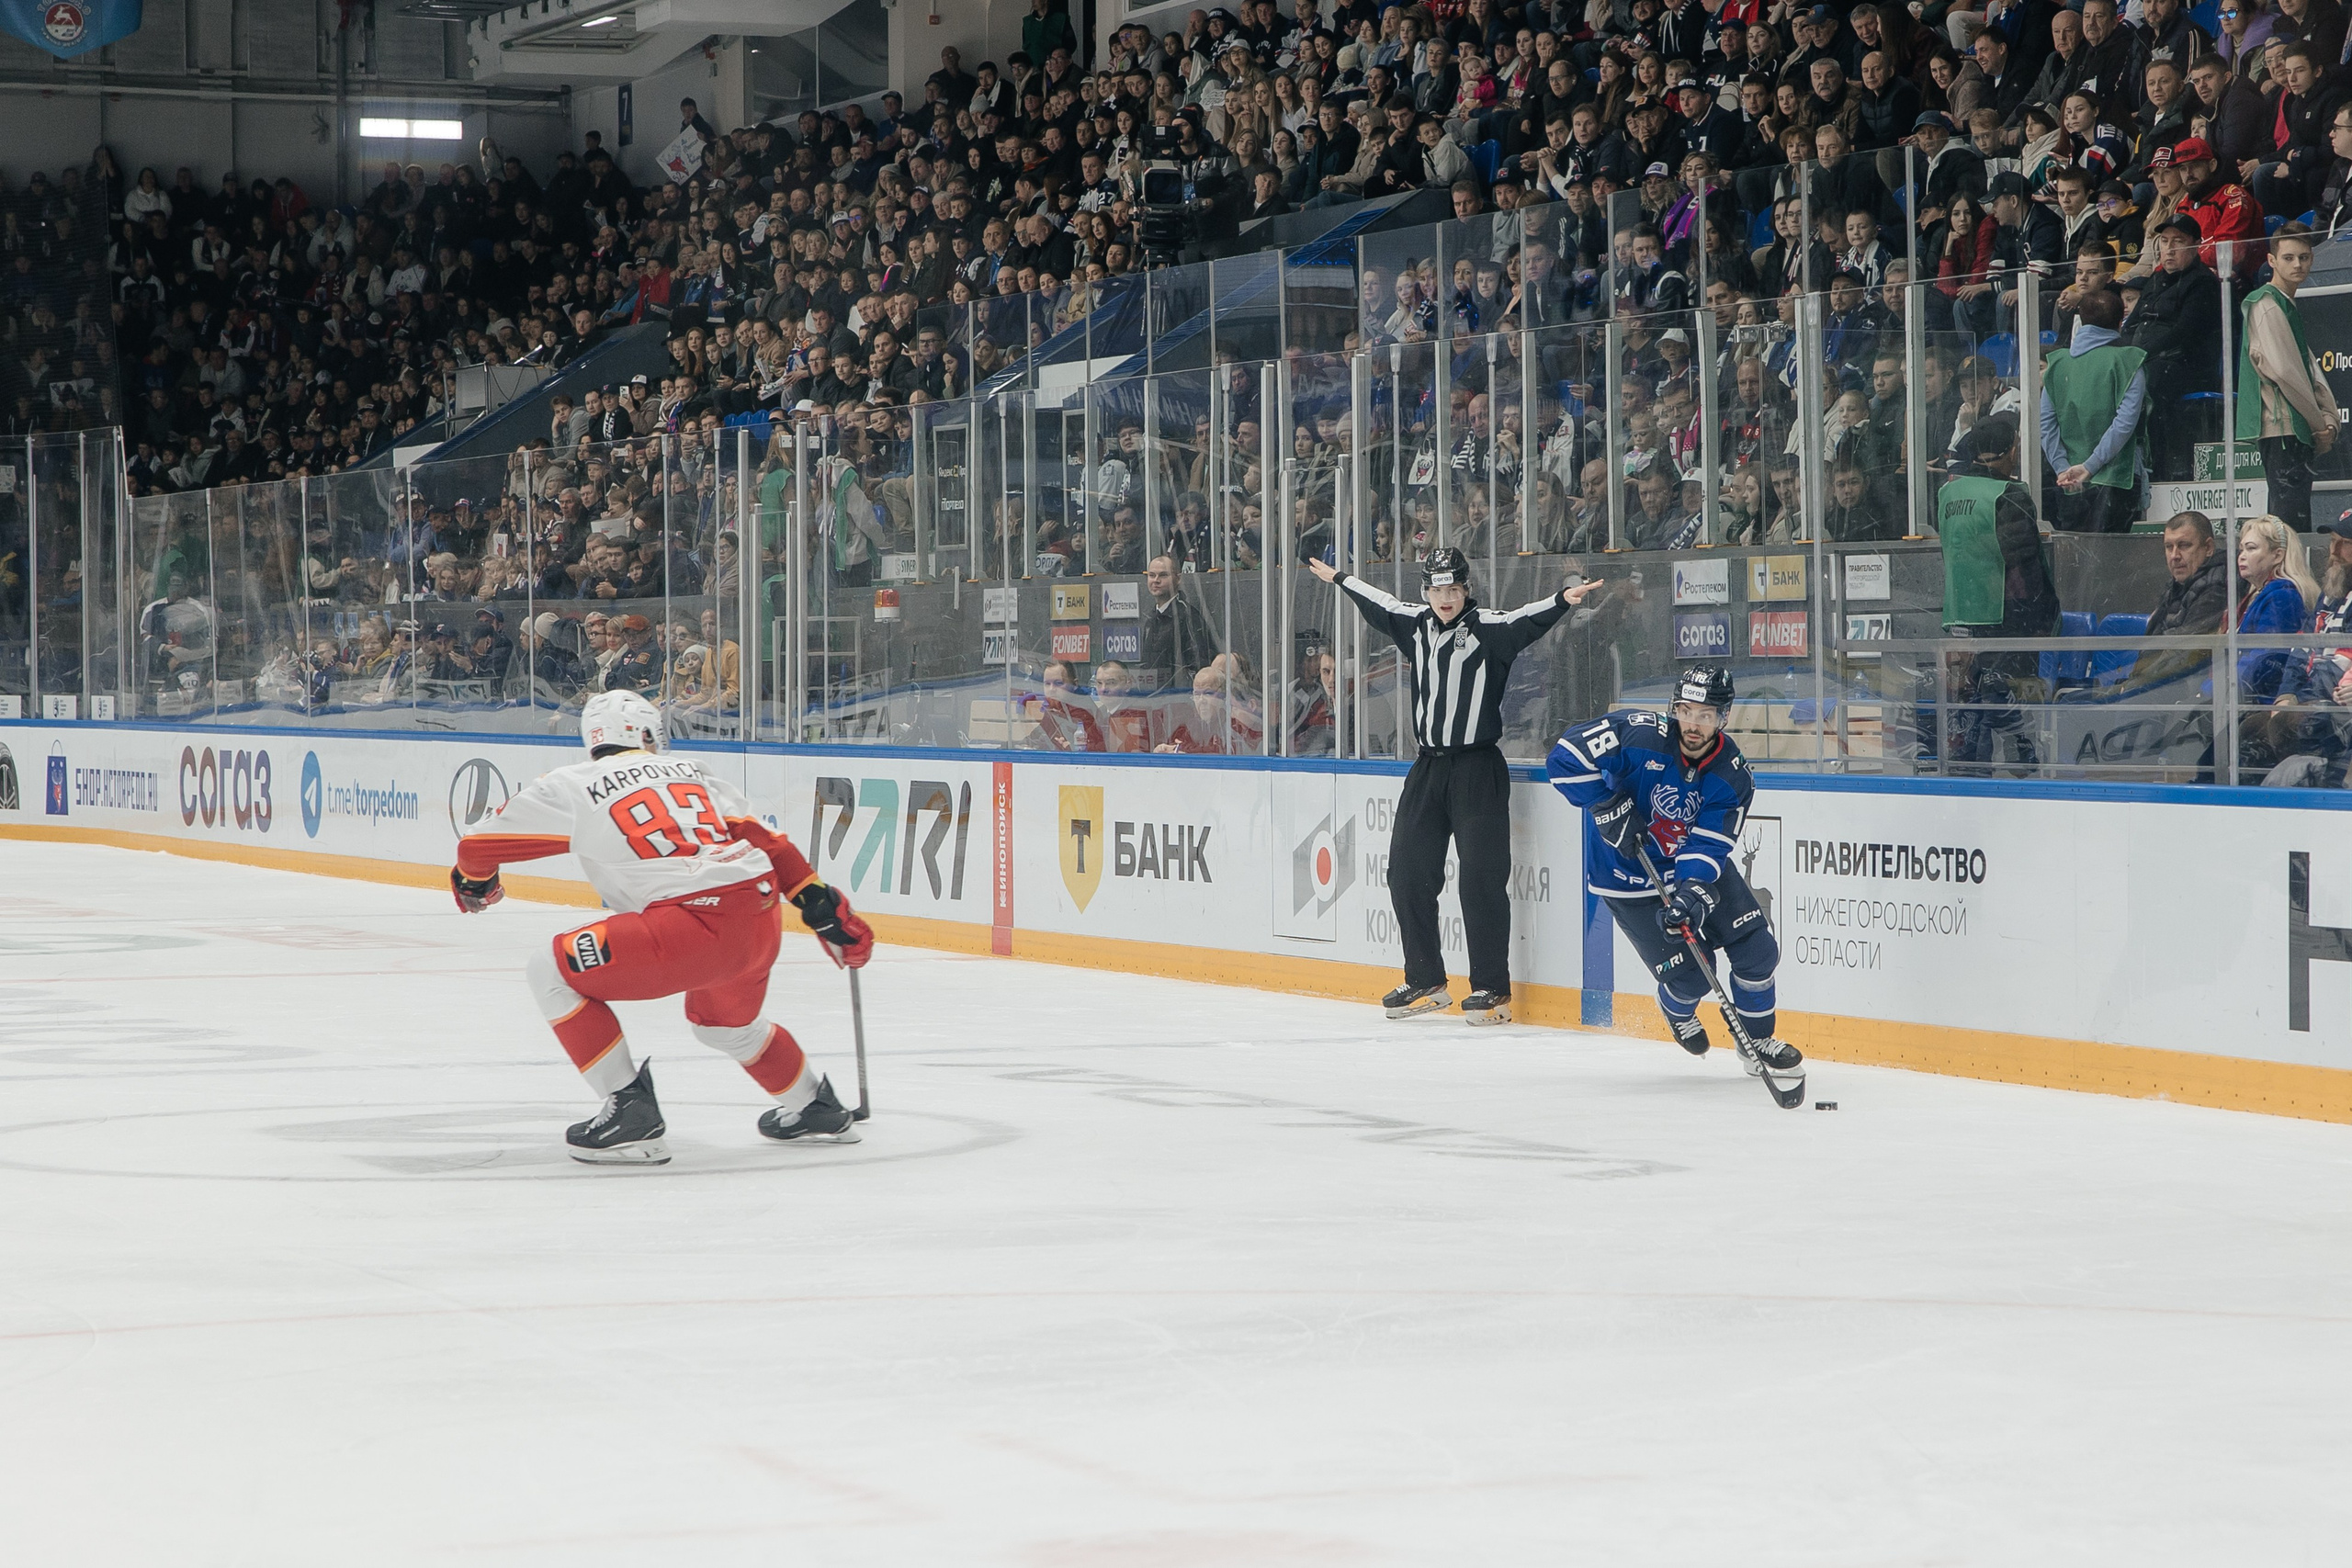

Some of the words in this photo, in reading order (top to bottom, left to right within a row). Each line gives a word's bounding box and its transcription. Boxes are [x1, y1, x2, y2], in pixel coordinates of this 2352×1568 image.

[621, 91, 628, 121] 7
[1098, 191, 1115, 205] 27
[1684, 581, 1726, 594] Ростелеком
[1772, 571, 1801, 586] БАНК
[1067, 596, 1085, 608] БАНК
[1052, 634, 1090, 653] FONBET
[1751, 622, 1805, 648] FONBET
[1581, 718, 1620, 759] 18
[586, 760, 706, 806] KARPOVICH
[328, 778, 418, 827] t.me/torpedonn
[1595, 797, 1634, 826] BAUER
[610, 782, 735, 860] 83
[1114, 821, 1213, 884] БАНК
[1795, 839, 1986, 885] ПРАВИТЕЛЬСТВО
[1733, 909, 1761, 929] CCM
[1795, 895, 1967, 937] НИЖЕГОРОДСКОЙ
[578, 936, 598, 966] WIN
[1795, 935, 1882, 971] ОБЛАСТИ
[1717, 991, 1764, 1072] WARRIOR
